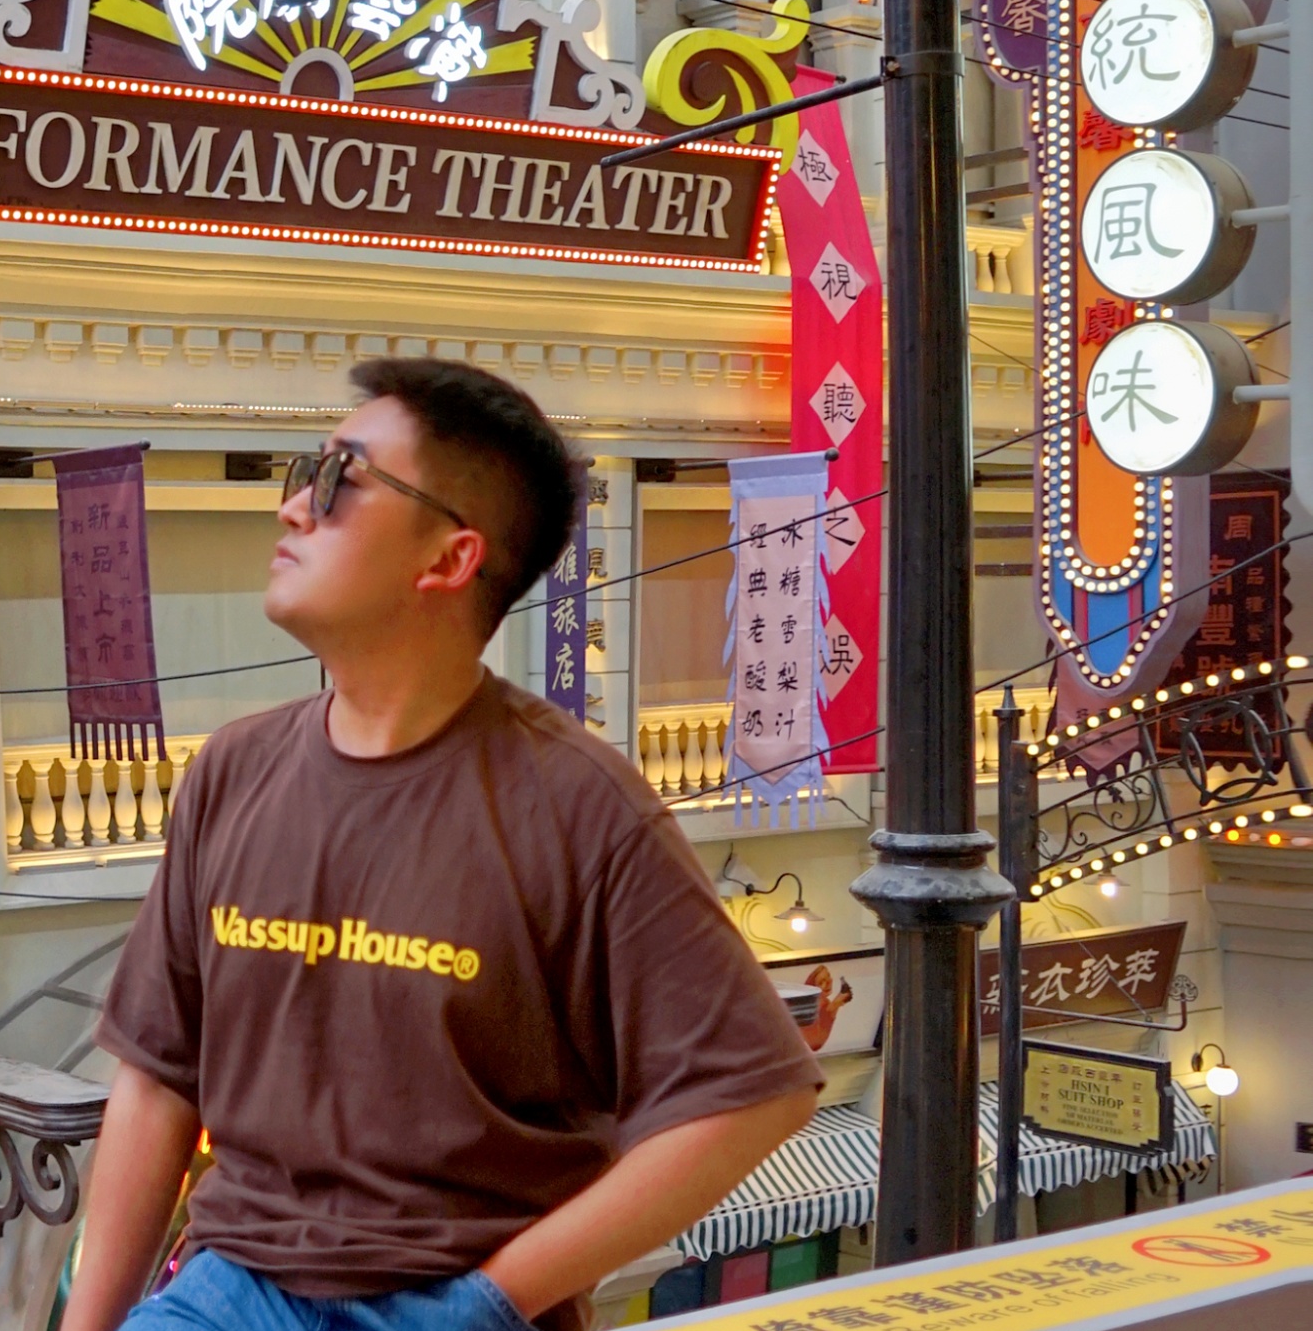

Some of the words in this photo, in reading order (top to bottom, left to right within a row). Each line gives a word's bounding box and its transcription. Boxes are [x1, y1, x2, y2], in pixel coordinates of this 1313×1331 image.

[432, 148, 734, 241] THEATER
[1058, 1088, 1086, 1104] SUIT
[1089, 1093, 1125, 1110] SHOP
[1070, 1078, 1101, 1094] HSIN
[1031, 1285, 1073, 1310] of
[1068, 1269, 1181, 1310] falling
